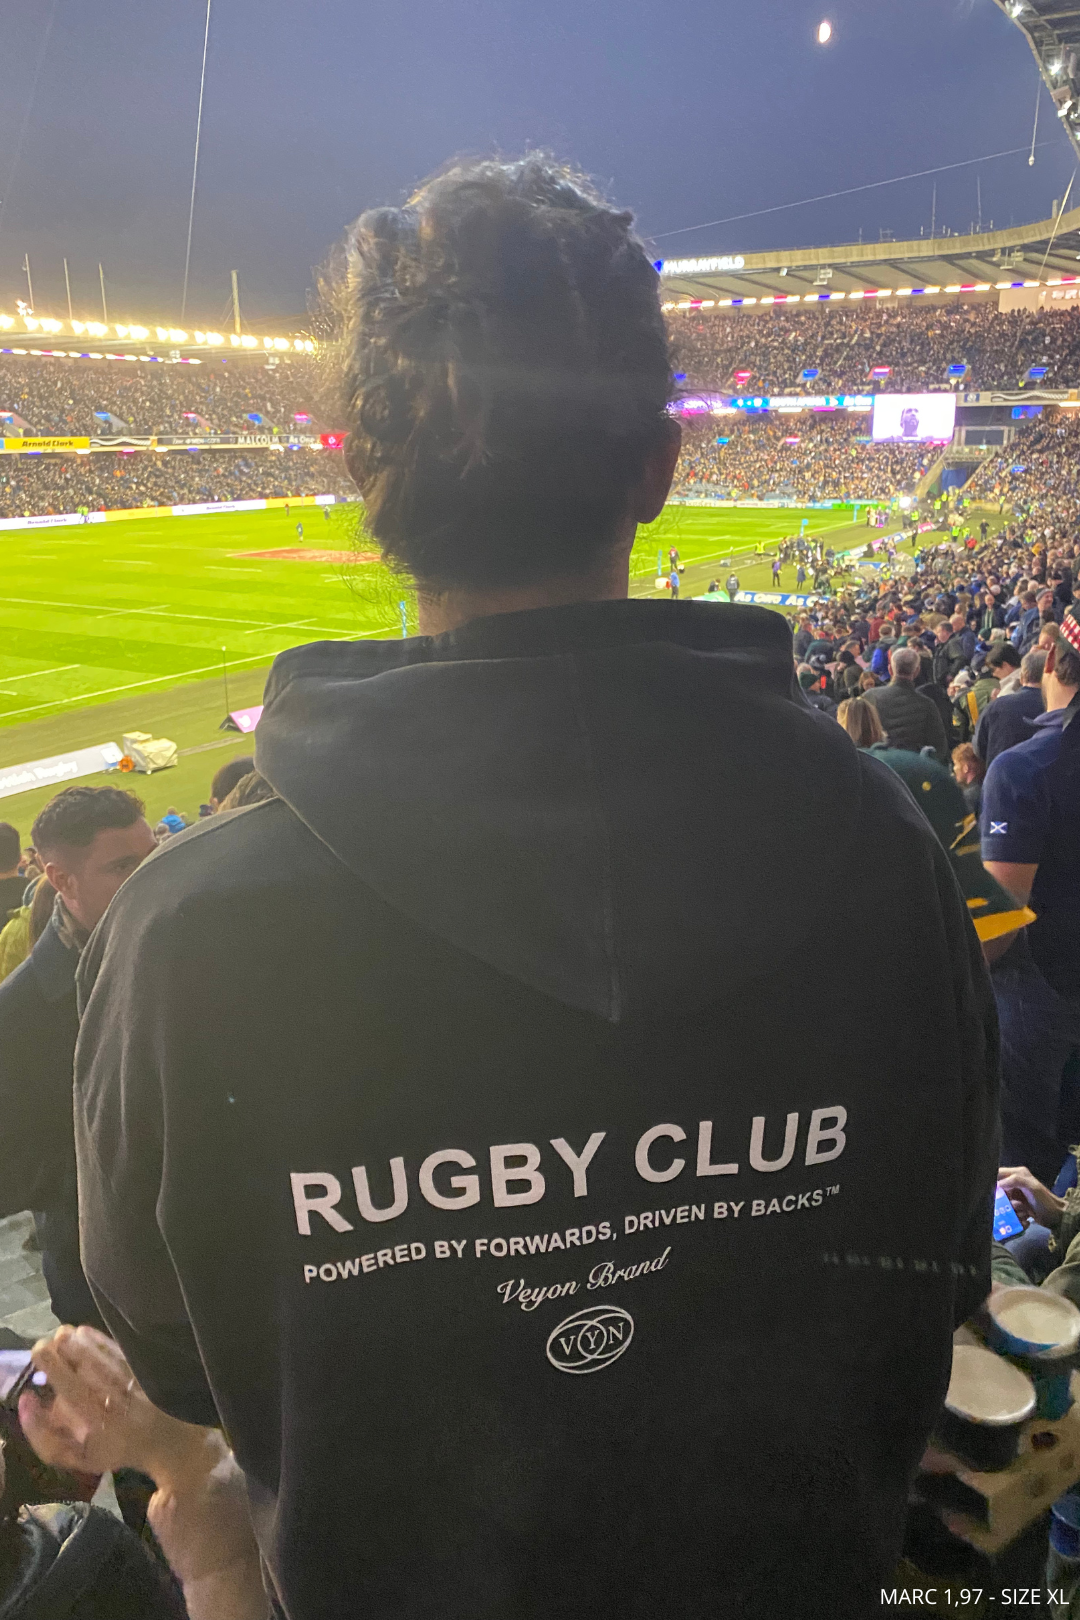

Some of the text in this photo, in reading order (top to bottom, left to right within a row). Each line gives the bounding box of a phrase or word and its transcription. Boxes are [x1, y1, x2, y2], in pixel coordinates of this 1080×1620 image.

[22, 440, 51, 448] Arnold
[238, 435, 280, 445] MALCOLM
[734, 590, 752, 603] As
[289, 1105, 848, 1236] RUGBY CLUB
[303, 1242, 427, 1284] POWERED
[433, 1239, 468, 1259] BY
[474, 1221, 618, 1258] FORWARDS,
[624, 1203, 706, 1235] DRIVEN
[713, 1201, 745, 1219] BY
[496, 1246, 672, 1312] Veyon Brand
[558, 1321, 625, 1356] VYN
